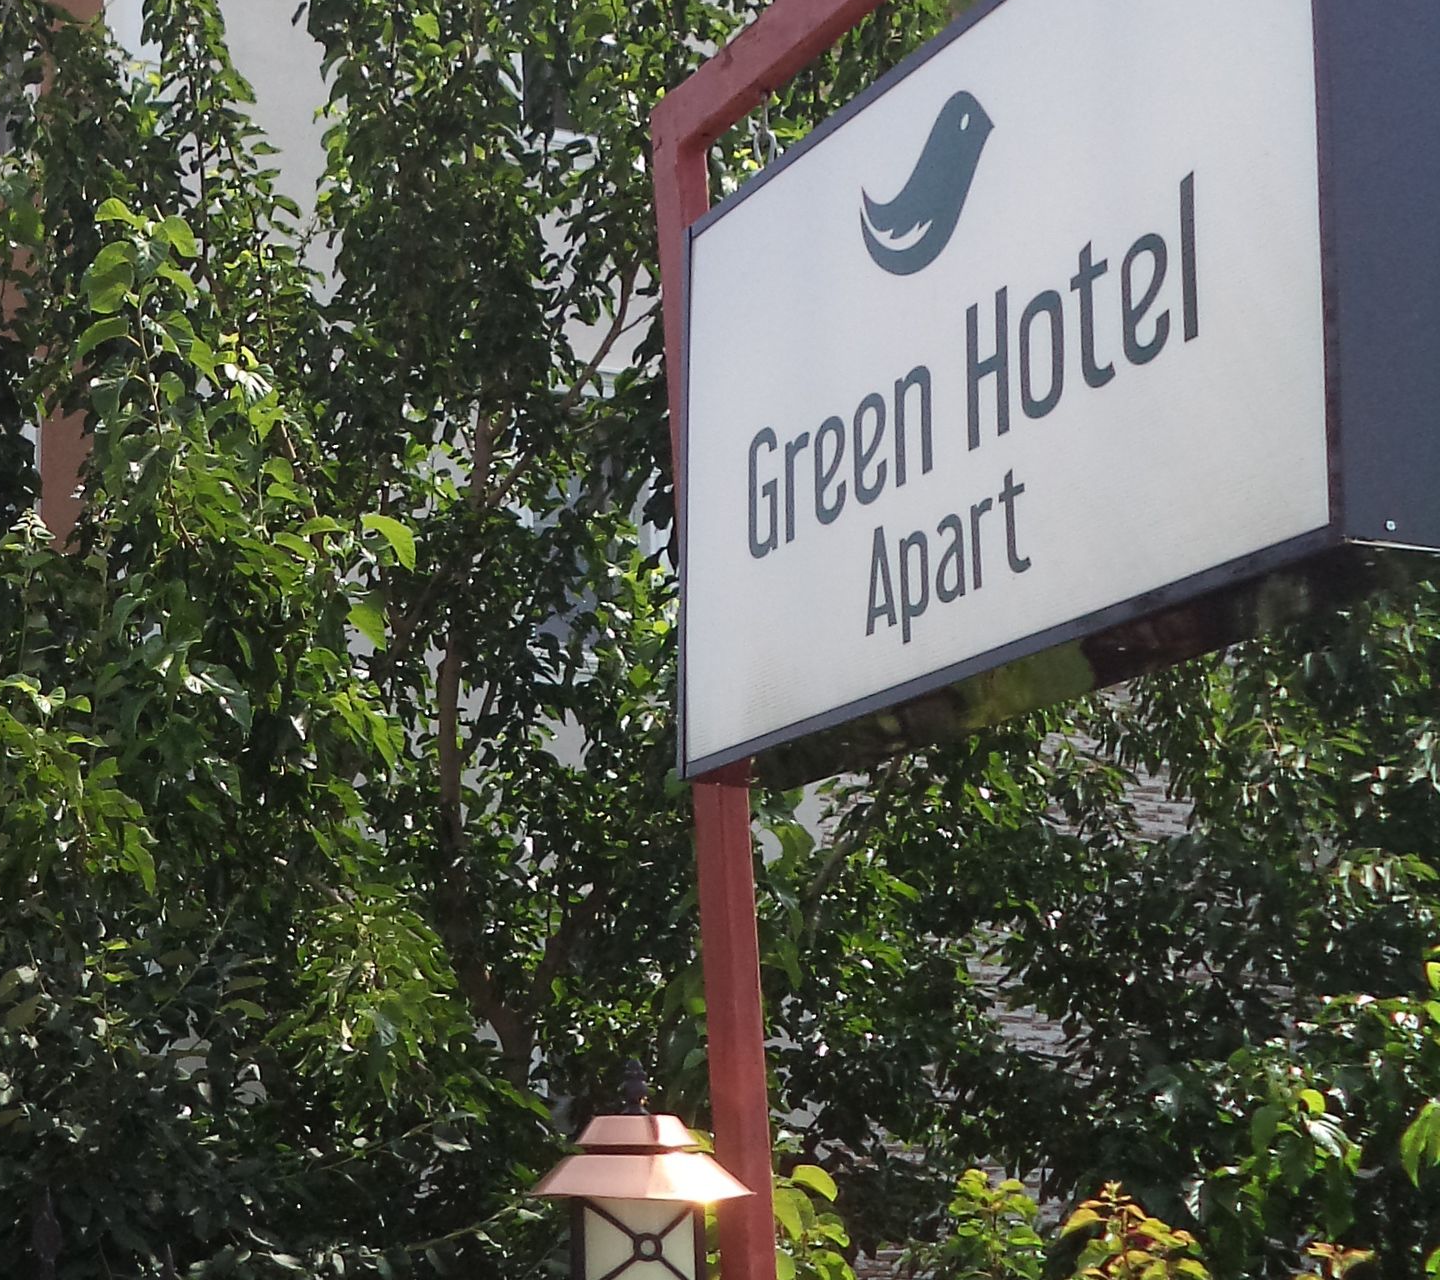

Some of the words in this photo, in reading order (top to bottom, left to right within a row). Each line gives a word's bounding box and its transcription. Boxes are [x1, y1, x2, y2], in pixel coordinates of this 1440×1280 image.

[748, 365, 933, 558] Green
[966, 171, 1198, 450] Hotel
[865, 470, 1032, 644] Apart
